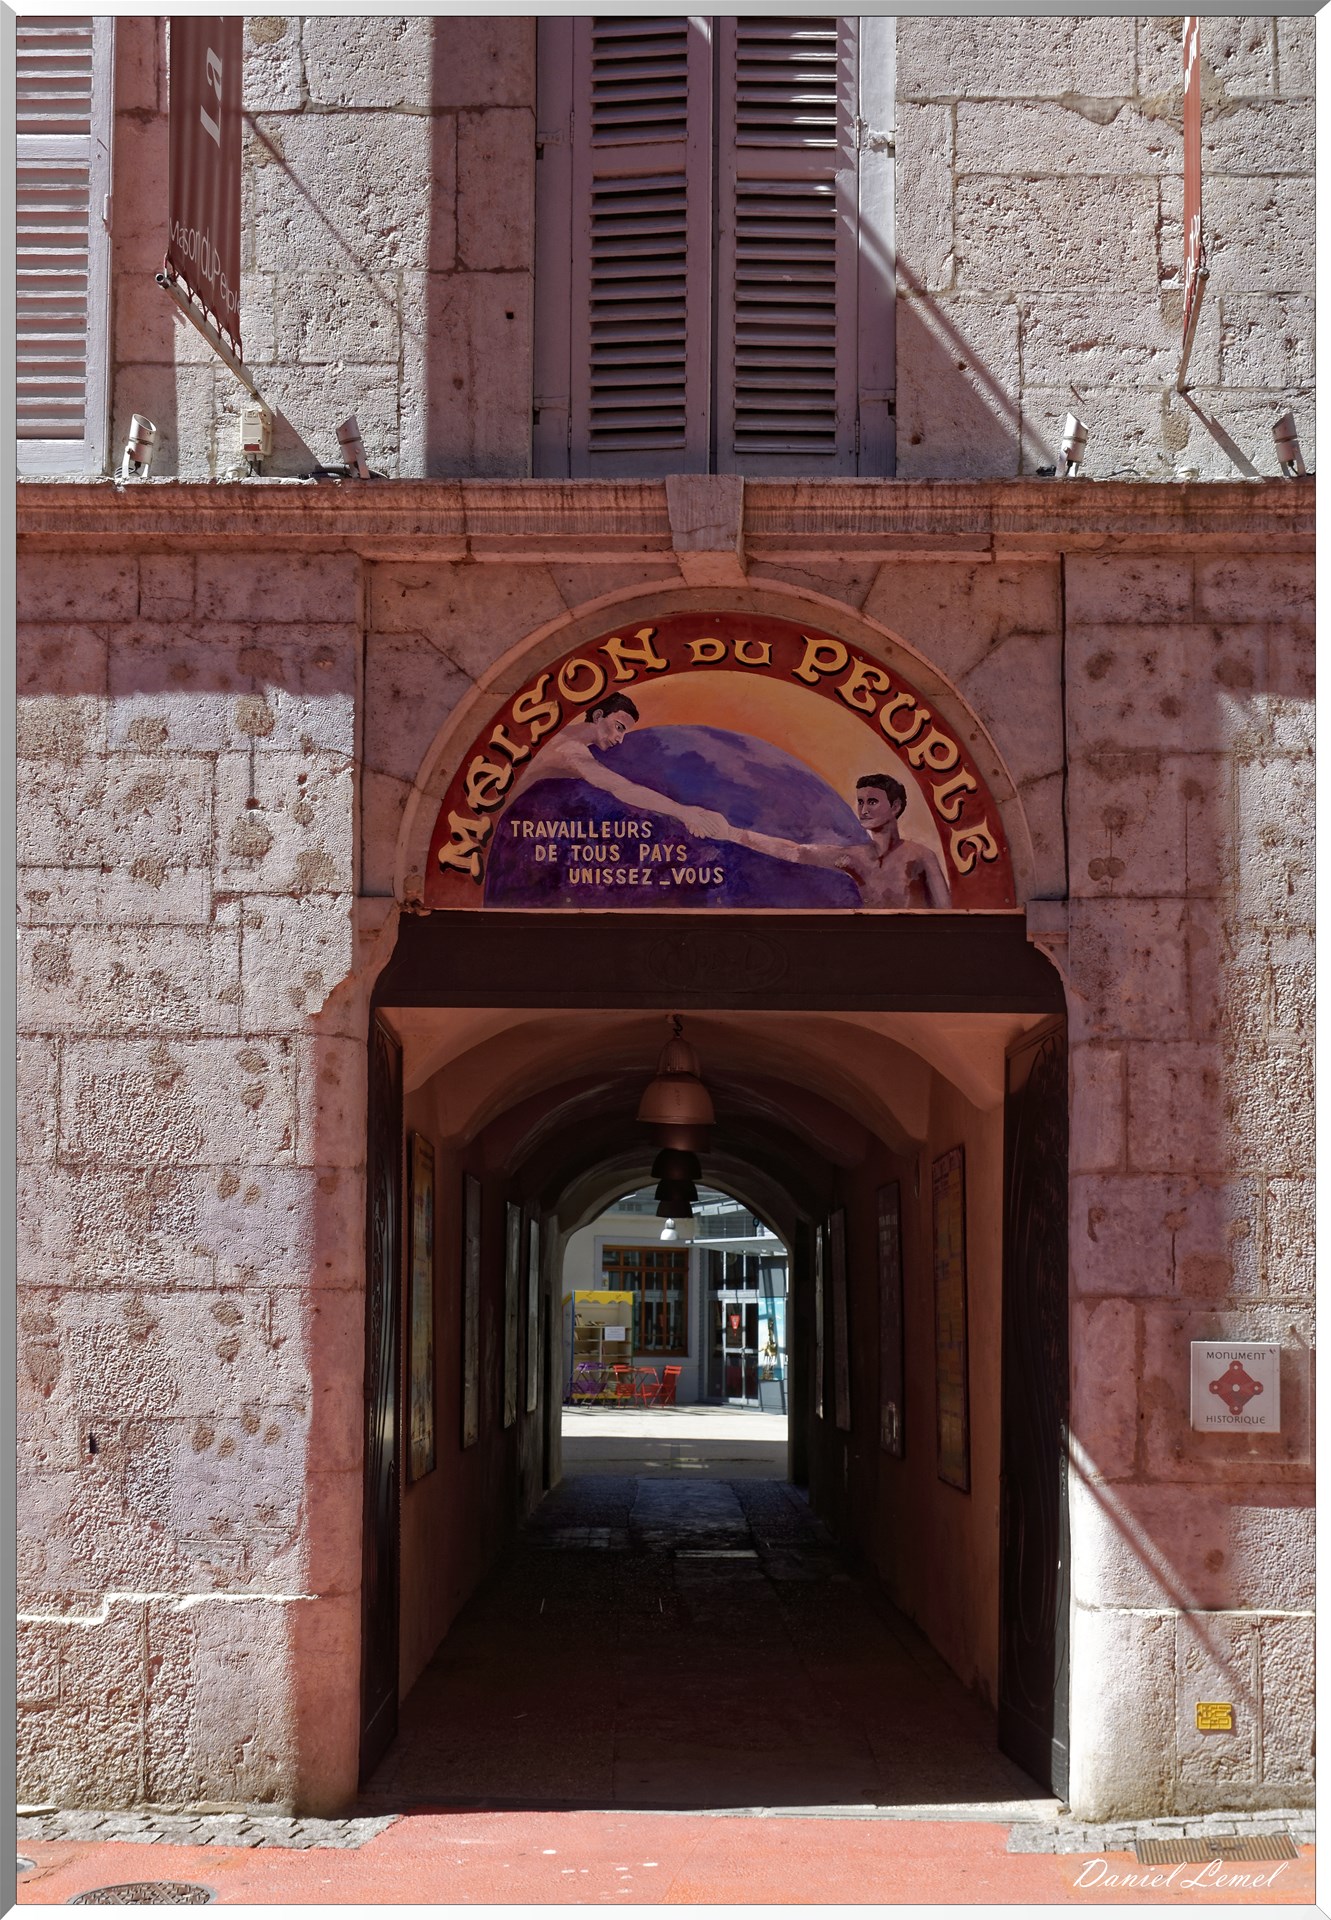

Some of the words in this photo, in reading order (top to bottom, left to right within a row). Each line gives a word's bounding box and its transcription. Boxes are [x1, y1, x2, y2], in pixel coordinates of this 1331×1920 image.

[200, 47, 223, 148] La
[439, 627, 670, 876] MAISON
[686, 638, 773, 666] DU
[794, 634, 1000, 875] PEUPLE
[510, 820, 652, 838] TRAVAILLEURS
[535, 843, 558, 862] DE
[571, 843, 620, 863] TOUS
[638, 843, 688, 863] PAYS
[568, 867, 652, 886] UNISSEZ
[1206, 1351, 1266, 1360] MONUMENT
[1206, 1415, 1266, 1425] HISTORIQUE
